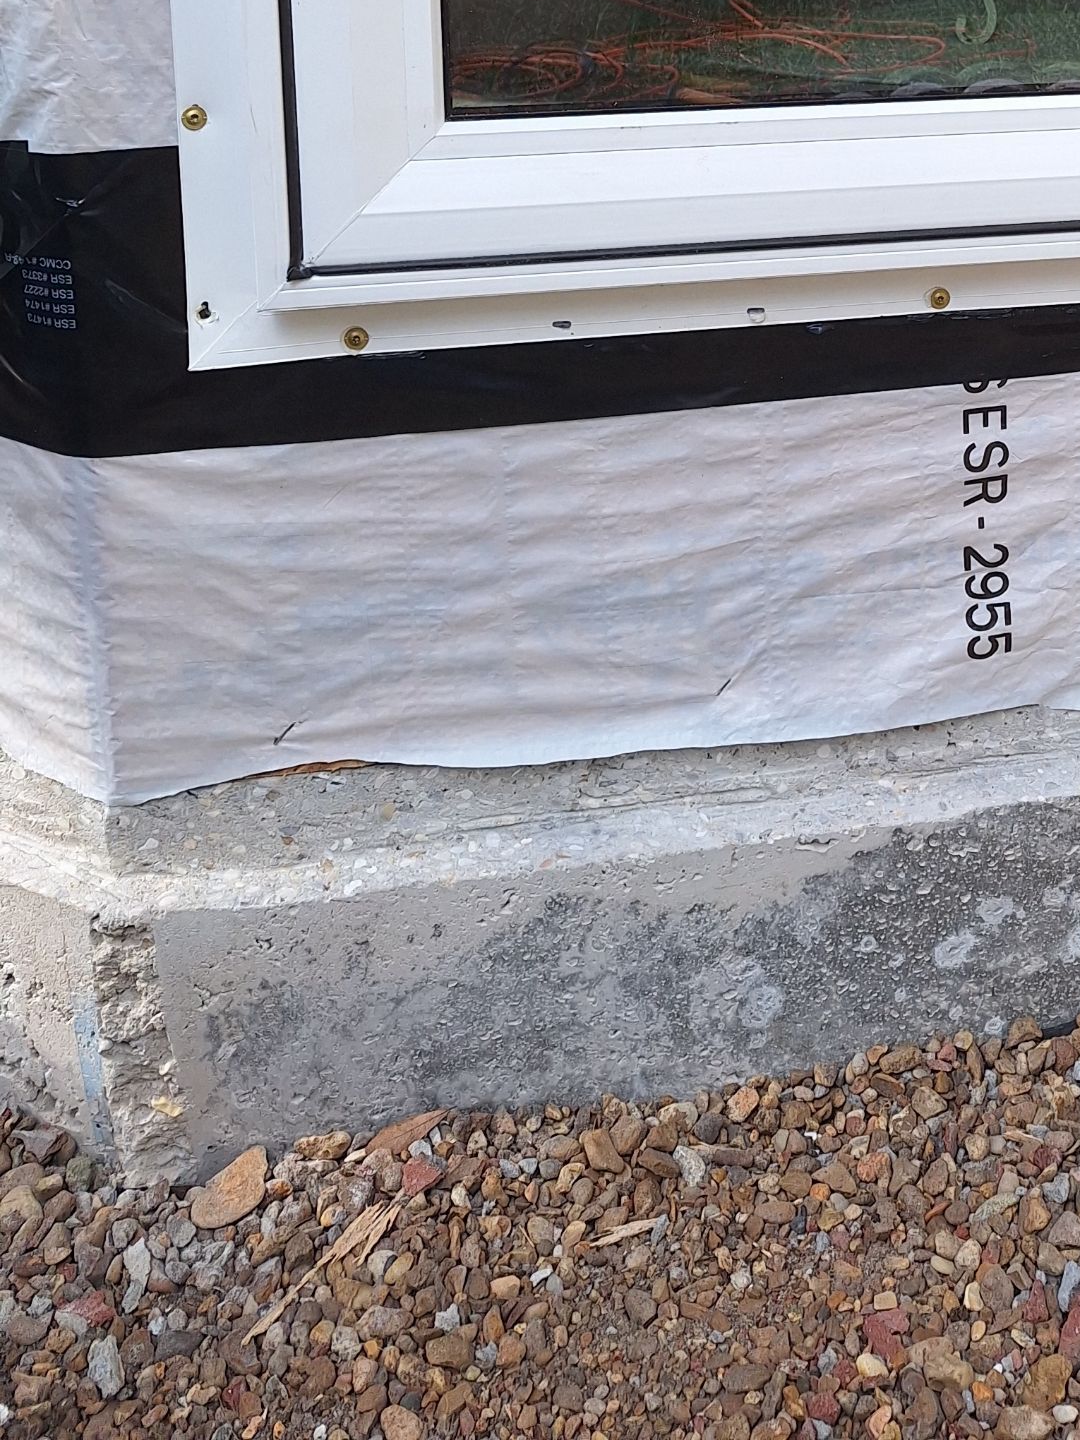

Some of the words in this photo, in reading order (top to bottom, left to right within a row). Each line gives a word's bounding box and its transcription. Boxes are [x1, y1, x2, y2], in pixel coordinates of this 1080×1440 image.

[40, 257, 71, 270] CCMC
[50, 273, 72, 285] ESR
[51, 288, 74, 299] ESR
[52, 303, 75, 314] ESR
[54, 318, 76, 329] ESR
[963, 404, 1010, 507] ESR
[963, 543, 1012, 661] 2955
